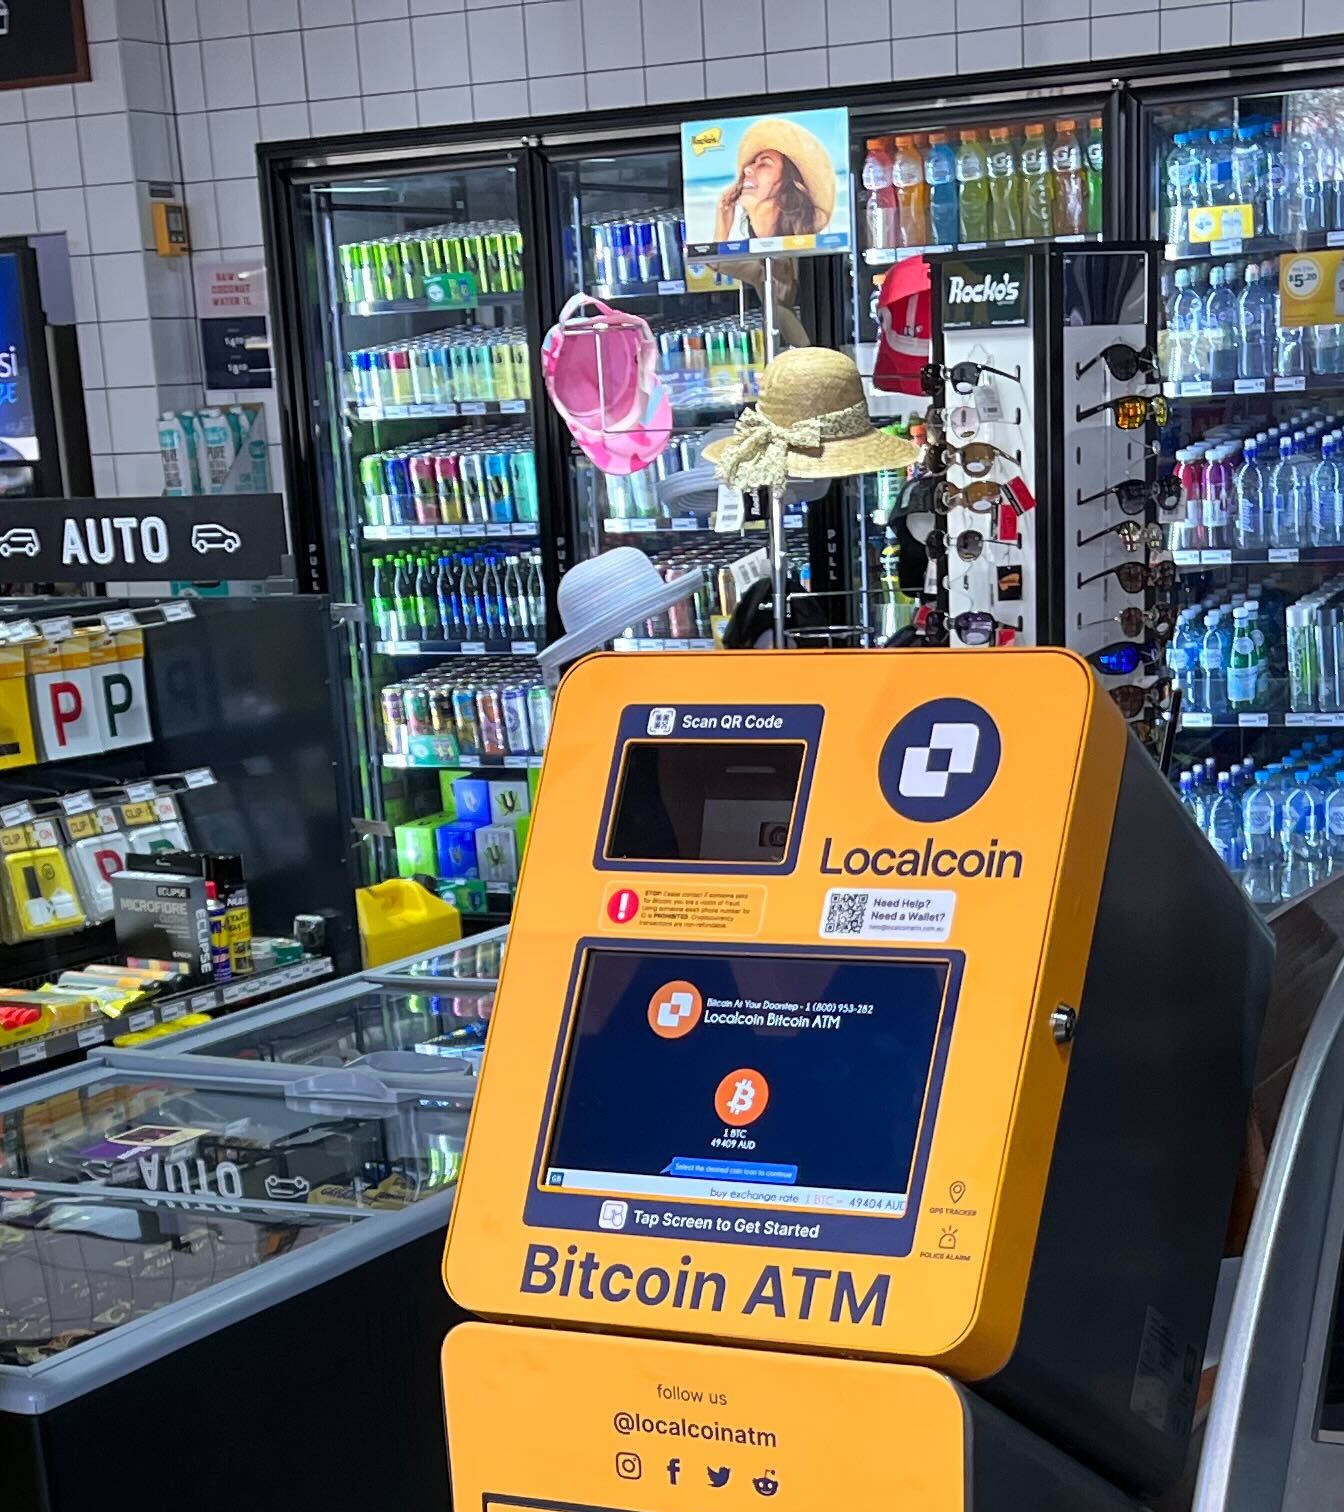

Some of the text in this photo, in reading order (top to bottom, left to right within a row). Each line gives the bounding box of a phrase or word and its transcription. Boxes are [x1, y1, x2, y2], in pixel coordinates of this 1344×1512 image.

[62, 516, 169, 567] AUTO
[49, 680, 83, 747] P
[102, 672, 133, 737] P
[682, 714, 784, 731] Scan QR Code
[819, 837, 1023, 880] Localcoin
[871, 911, 898, 921] Need
[908, 911, 946, 922] Wallet?
[873, 898, 931, 910] Need Help?
[704, 1010, 841, 1030] Localcoin Bitcoin ATM
[710, 1187, 728, 1199] buy
[730, 1189, 777, 1202] exchange
[780, 1193, 799, 1203] rate
[849, 1197, 883, 1209] 49404
[634, 1209, 821, 1240] Tap Screen to Get Started
[520, 1244, 892, 1327] Bitcoin ATM
[656, 1383, 728, 1406] follow us
[613, 1411, 777, 1448] @localcoinatm
